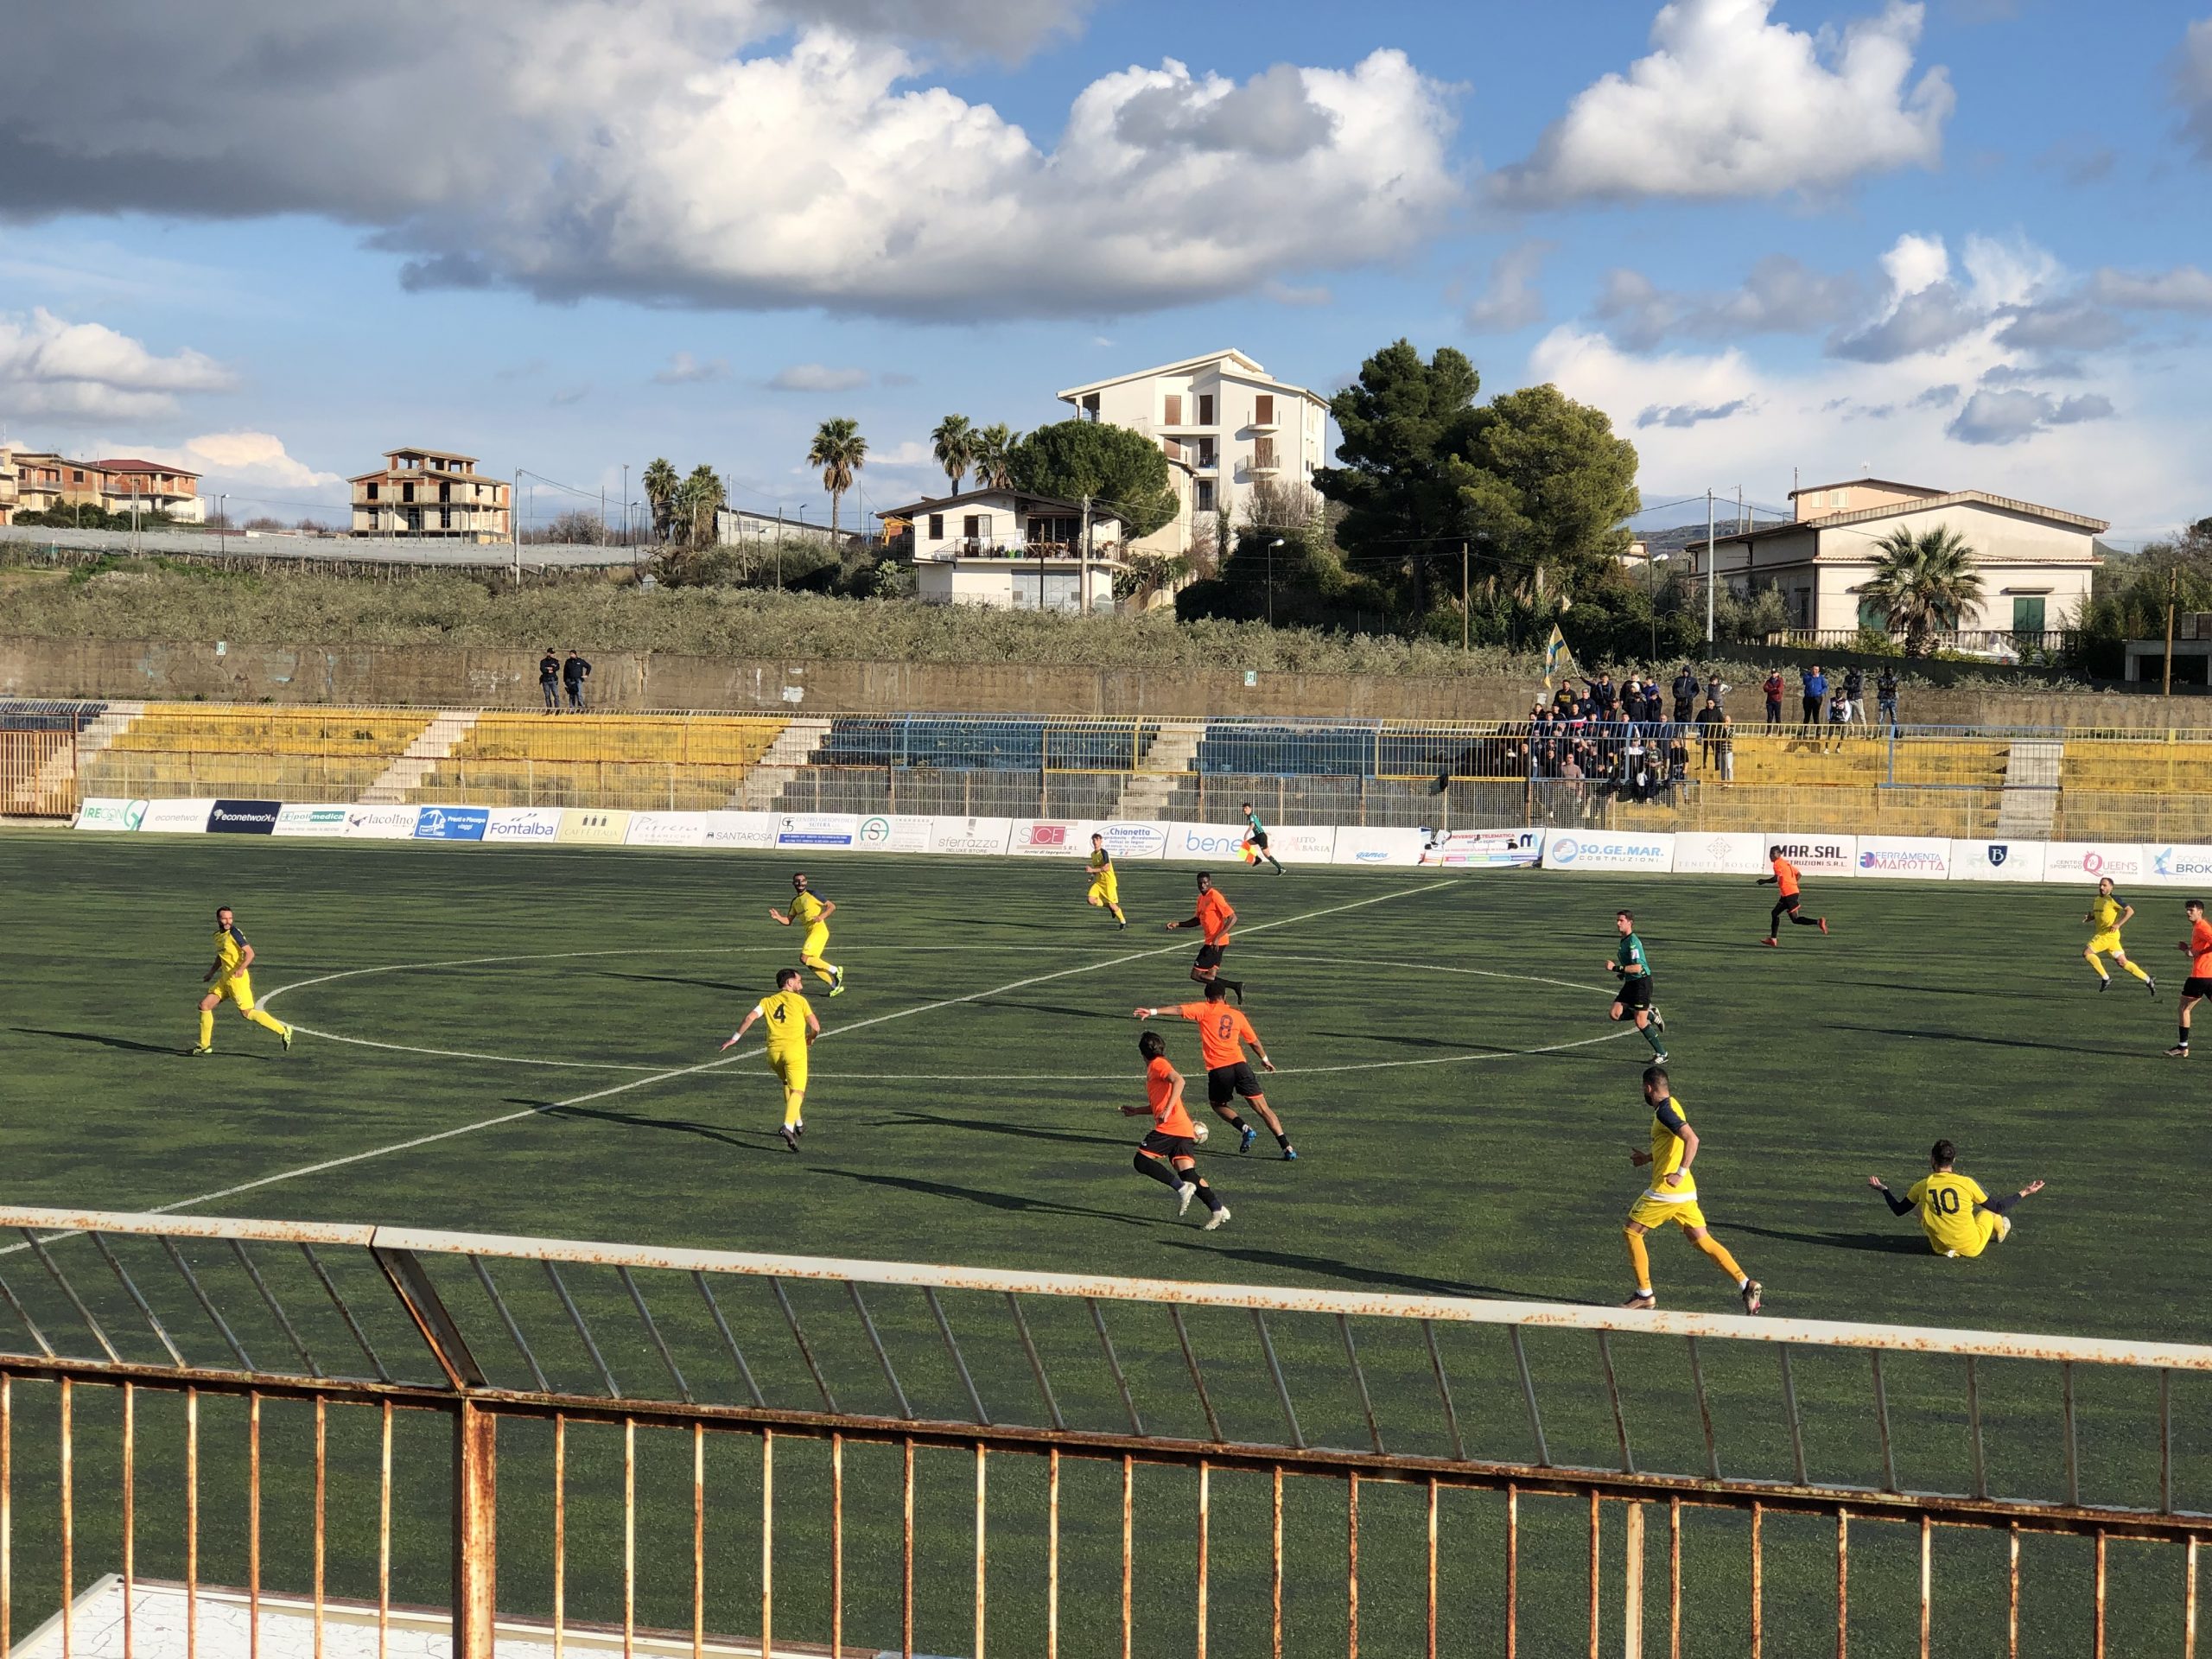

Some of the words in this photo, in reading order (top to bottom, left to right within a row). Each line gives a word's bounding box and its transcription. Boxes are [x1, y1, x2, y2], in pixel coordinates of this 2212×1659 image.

[293, 812, 344, 822] polimedica
[489, 823, 554, 836] Fontalba
[715, 832, 773, 842] SANTAROSA
[938, 836, 999, 849] sferrazza
[1580, 843, 1664, 857] SO.GE.MAR.
[1875, 851, 1942, 861] FERRAMENTA
[1992, 849, 2004, 861] B
[1874, 860, 1945, 871] MAROTTA
[773, 1003, 786, 1024] 4
[1218, 1014, 1234, 1040] 8
[1928, 1187, 1961, 1217] 10
